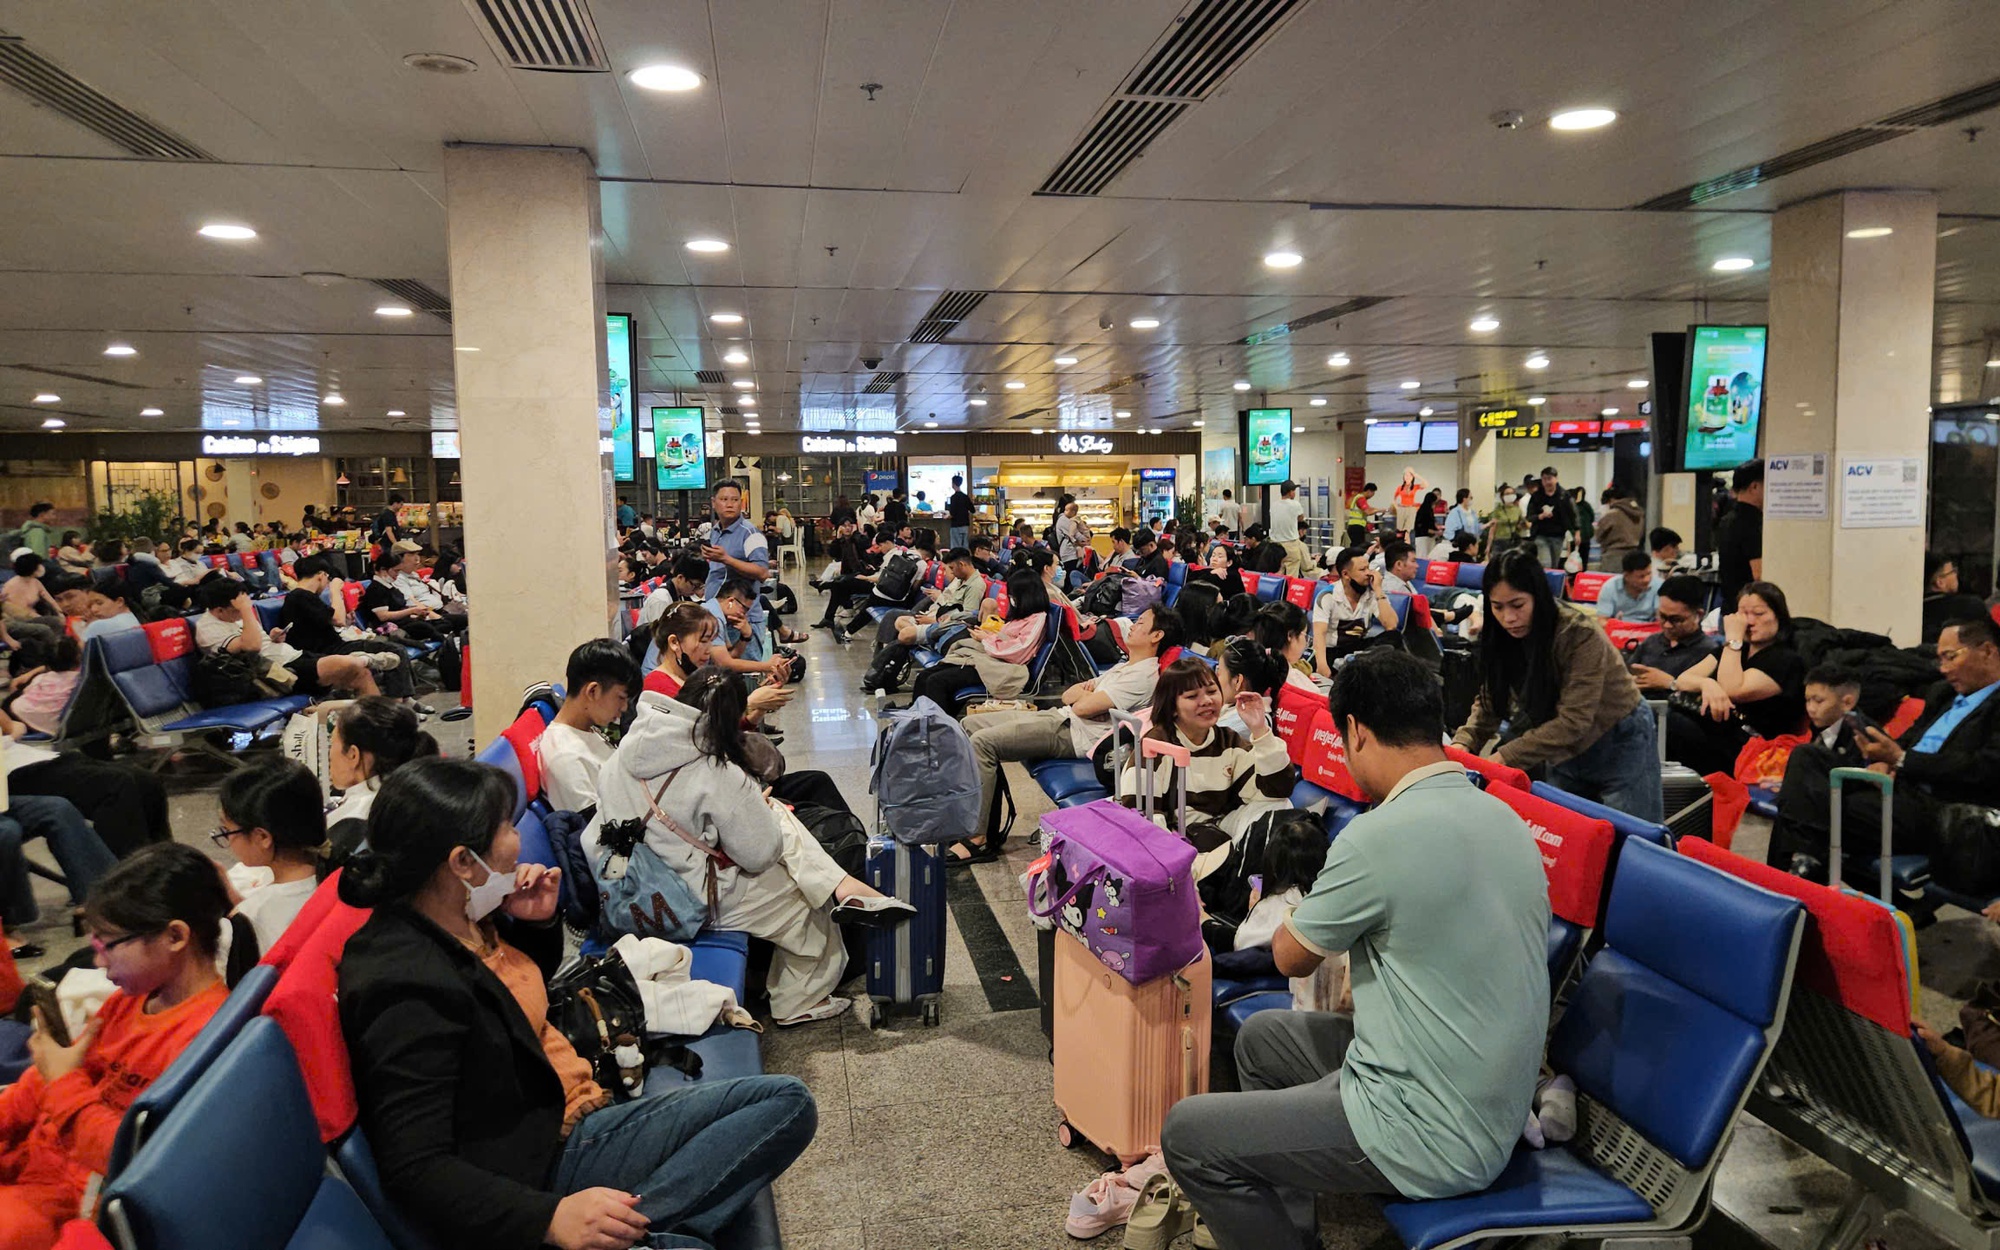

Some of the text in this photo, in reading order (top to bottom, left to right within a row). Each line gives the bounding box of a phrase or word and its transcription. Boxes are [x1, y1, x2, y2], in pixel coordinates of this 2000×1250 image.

[1769, 460, 1789, 470] ACV
[1847, 465, 1873, 476] ACV
[629, 891, 683, 933] M
